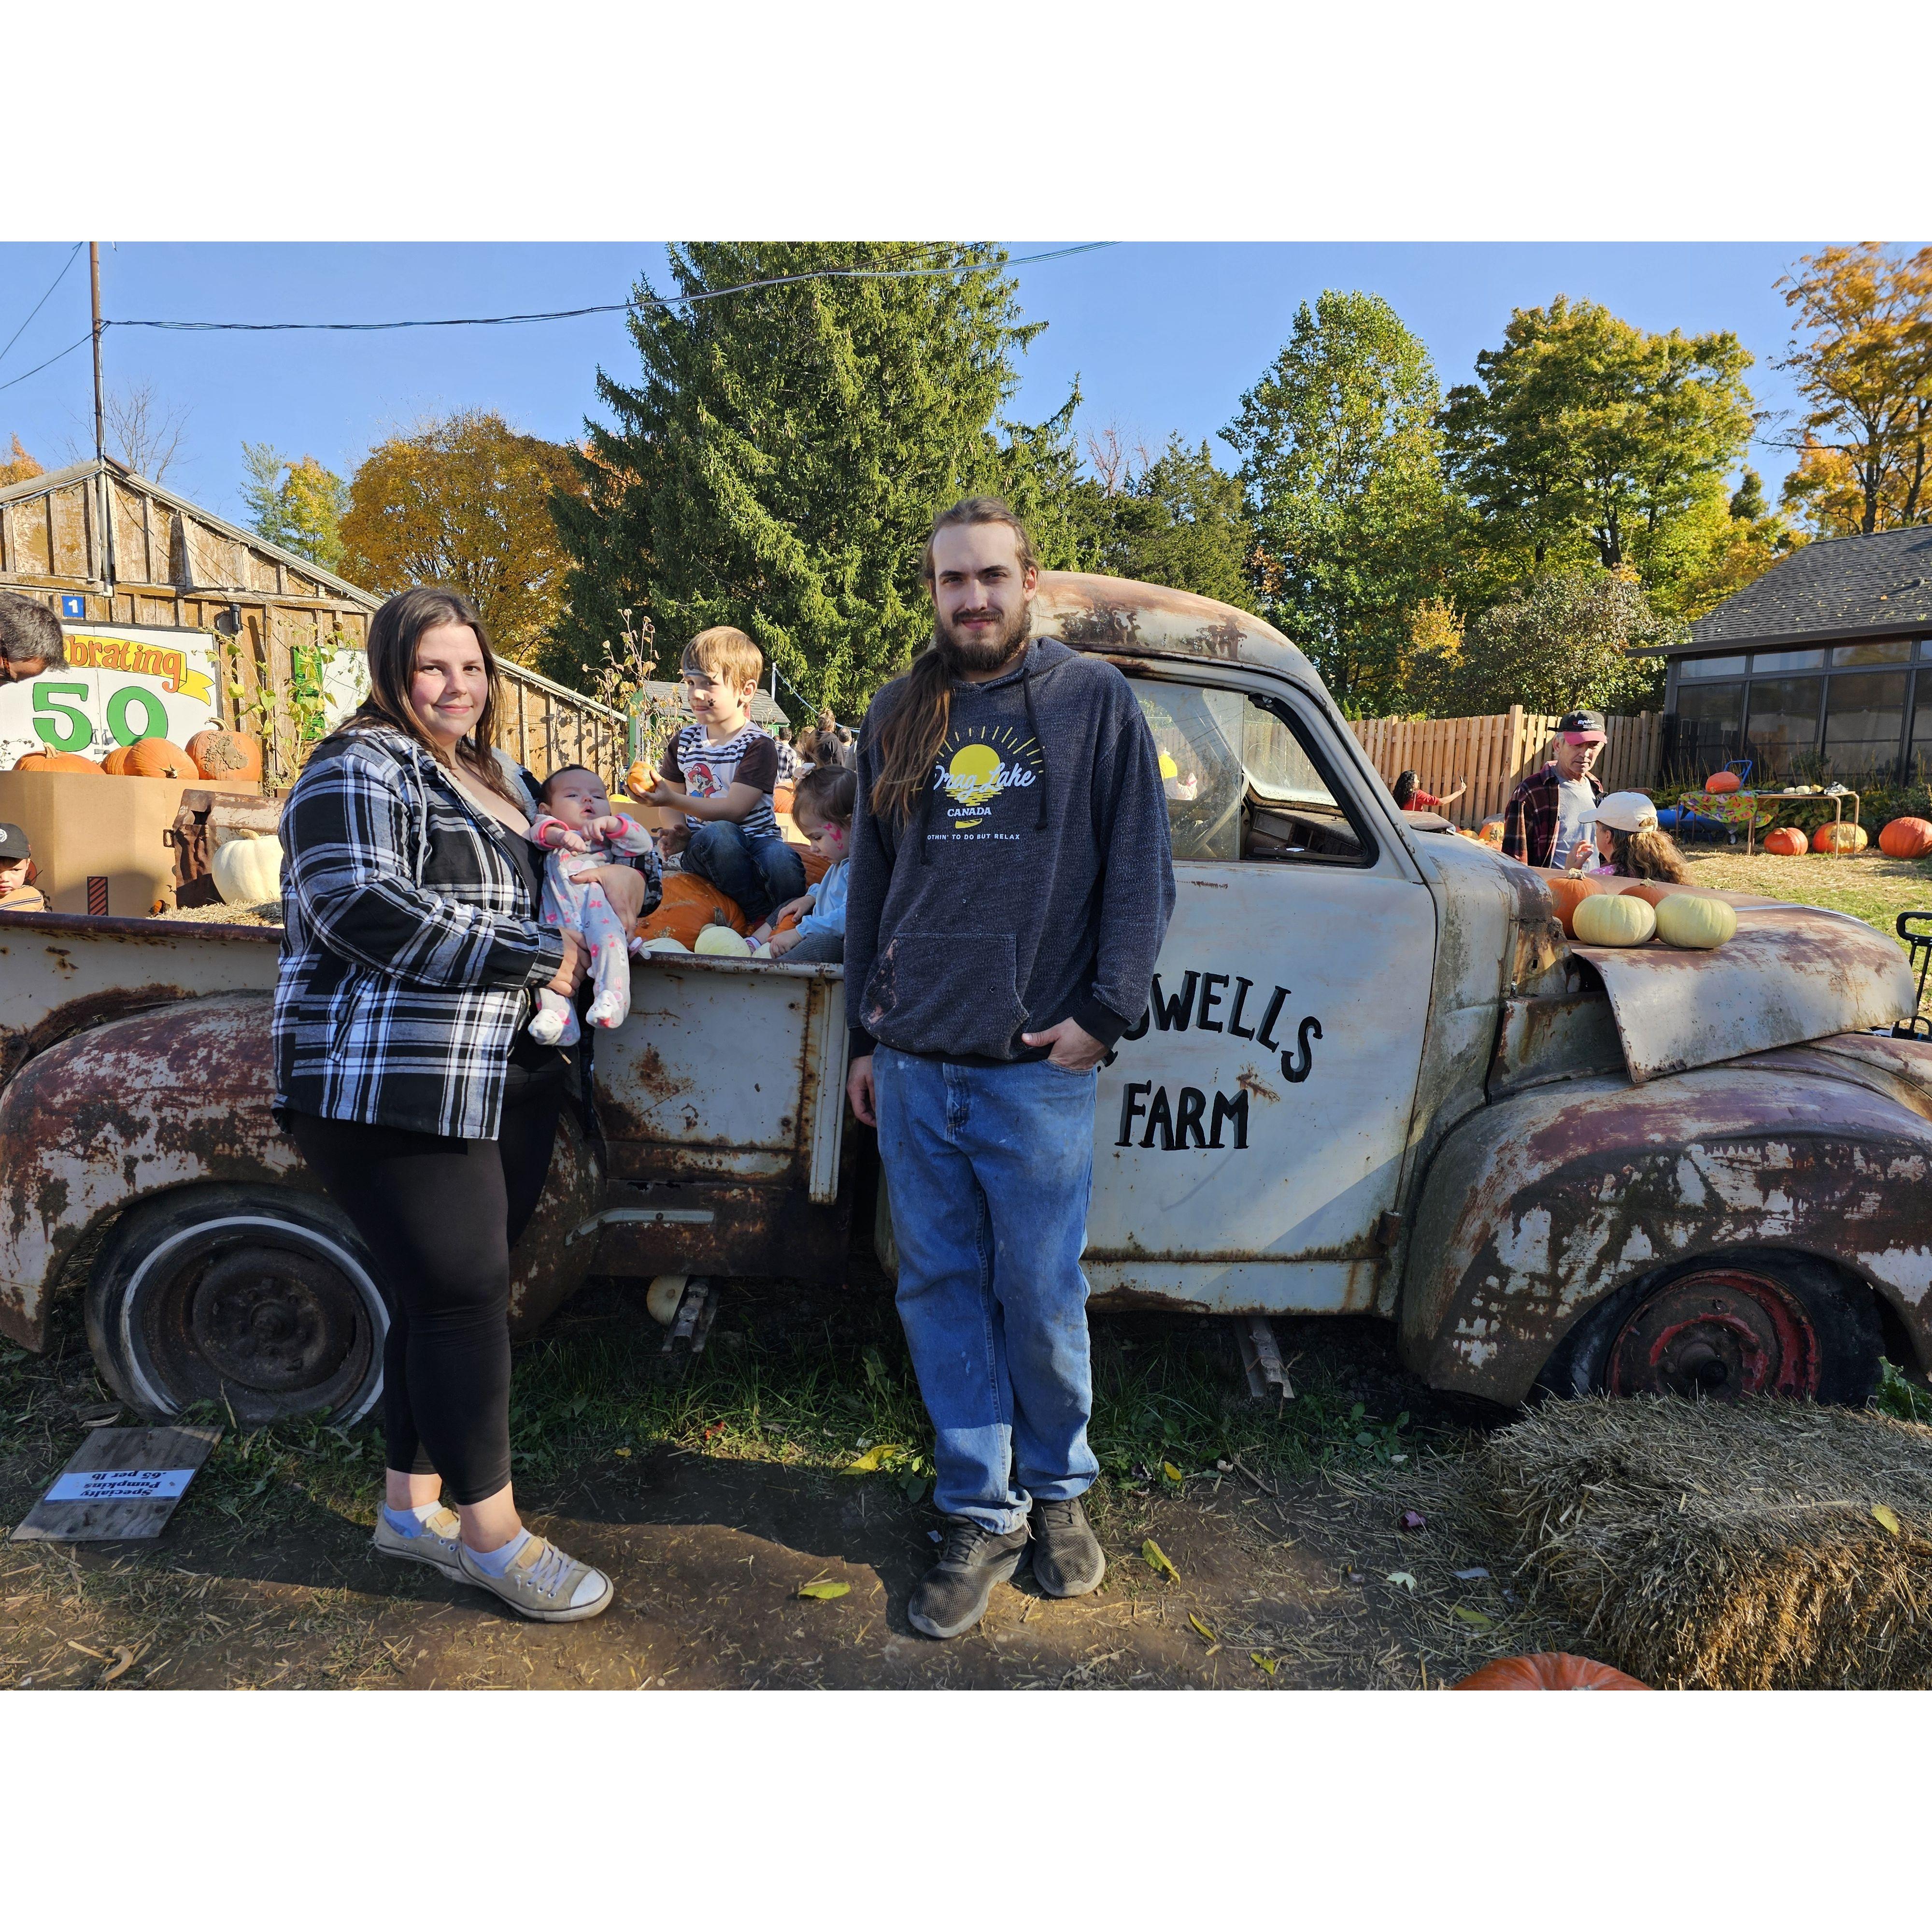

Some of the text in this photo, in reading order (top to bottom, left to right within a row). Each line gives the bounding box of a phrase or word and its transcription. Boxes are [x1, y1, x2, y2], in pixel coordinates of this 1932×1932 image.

[68, 599, 78, 613] 1
[63, 635, 181, 693] brating
[32, 682, 168, 752] 50
[979, 762, 1036, 793] Lake
[947, 807, 992, 817] CANADA
[1097, 970, 1323, 1083] WELLS
[1114, 1080, 1250, 1151] FARM
[81, 1489, 153, 1497] Specialty
[84, 1480, 162, 1490] Pumpkins
